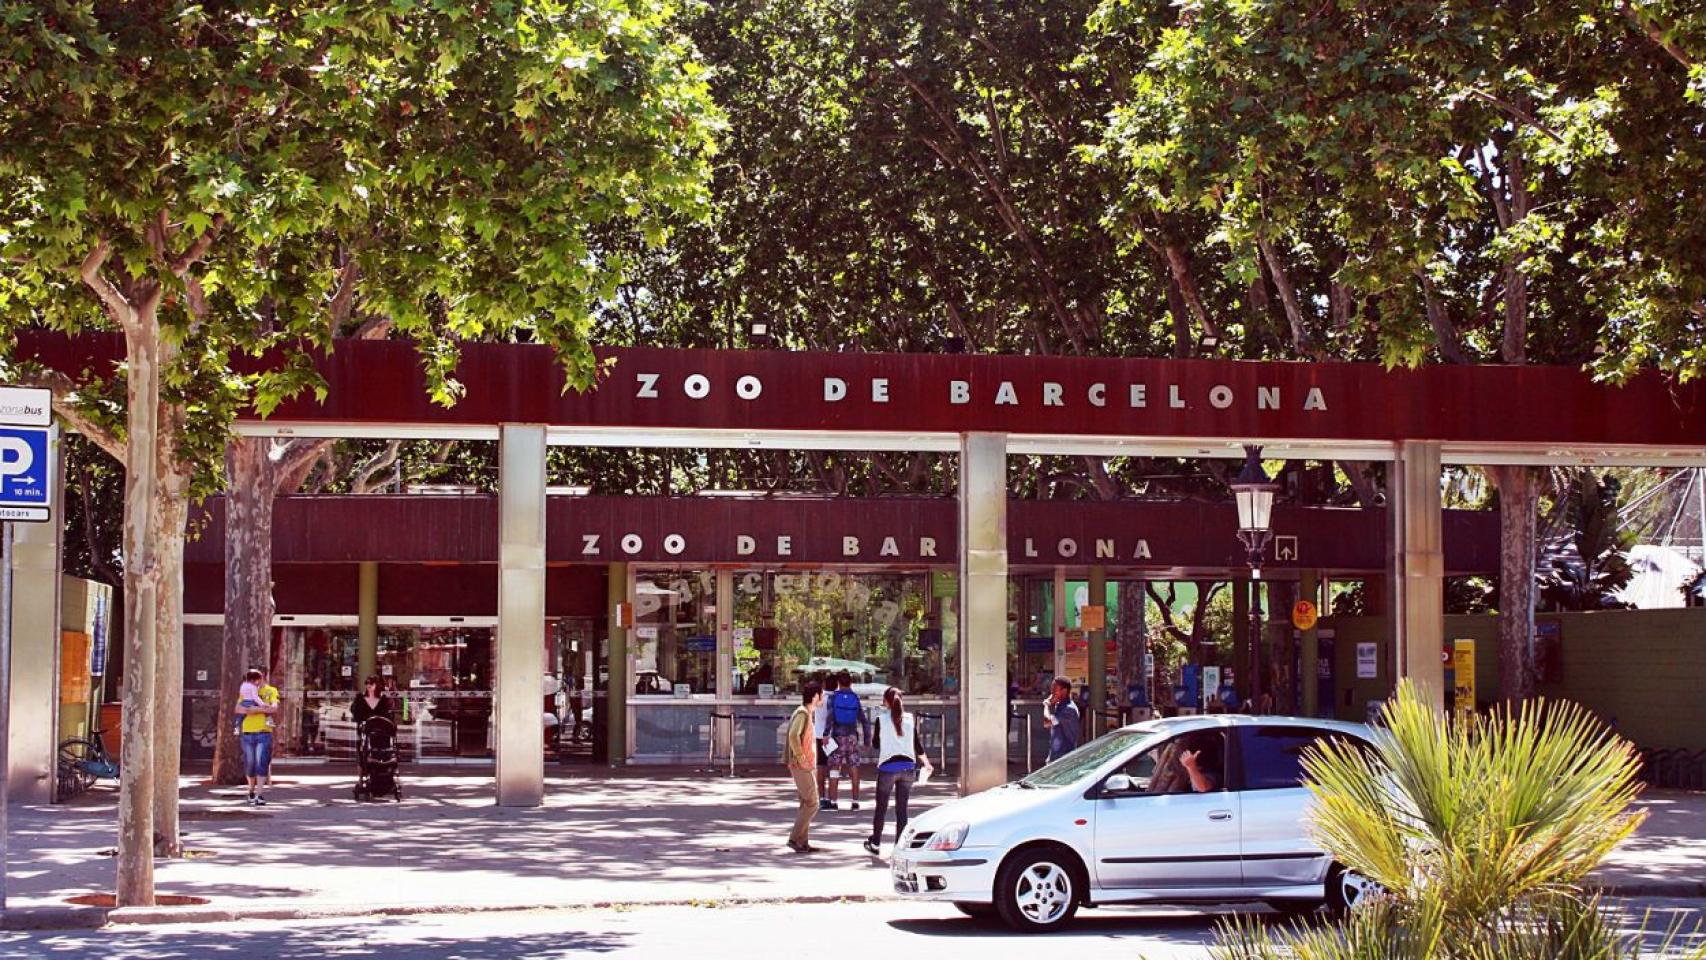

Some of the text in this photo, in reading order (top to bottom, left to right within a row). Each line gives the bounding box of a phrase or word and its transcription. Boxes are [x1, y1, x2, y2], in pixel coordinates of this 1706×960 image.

[636, 373, 1328, 411] ZOO DE BARCELONA
[0, 436, 33, 493] P
[14, 488, 23, 497] 10
[582, 533, 1153, 560] ZOO DE BARLONA
